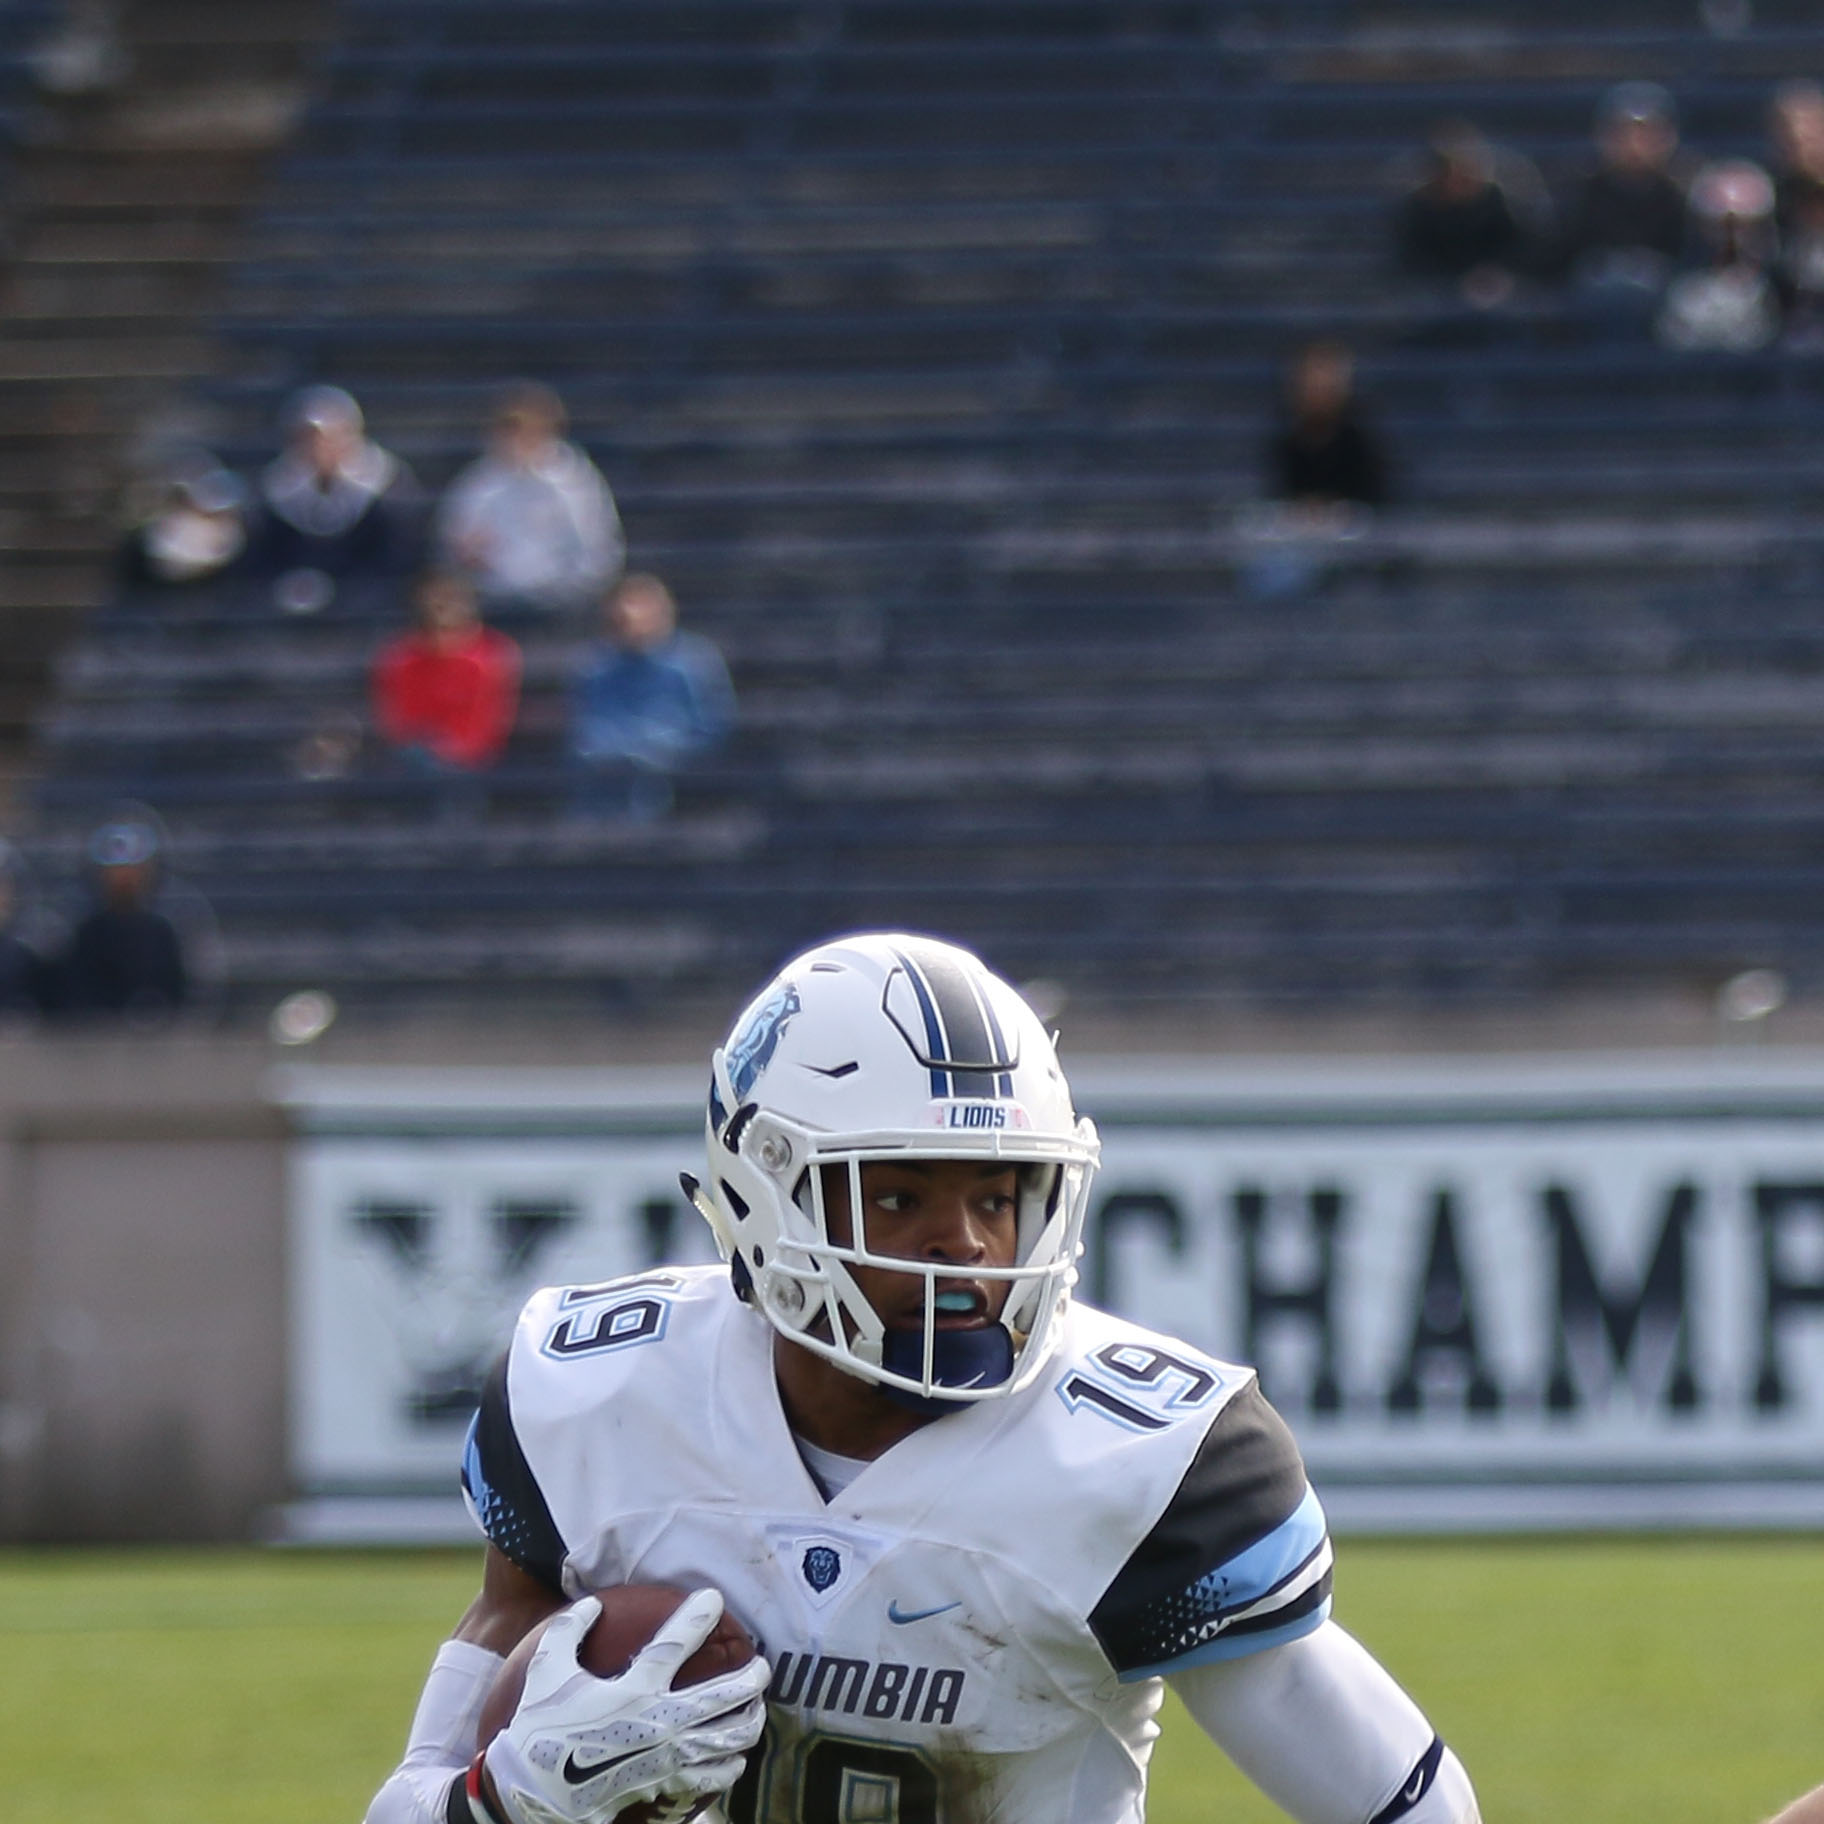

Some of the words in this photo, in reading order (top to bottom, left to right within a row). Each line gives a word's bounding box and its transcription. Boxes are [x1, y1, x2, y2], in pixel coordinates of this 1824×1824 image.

[948, 1104, 1006, 1129] LIONS
[540, 1276, 683, 1361] 19
[1055, 1340, 1224, 1435] 19
[756, 1650, 966, 1726] UMBIA
